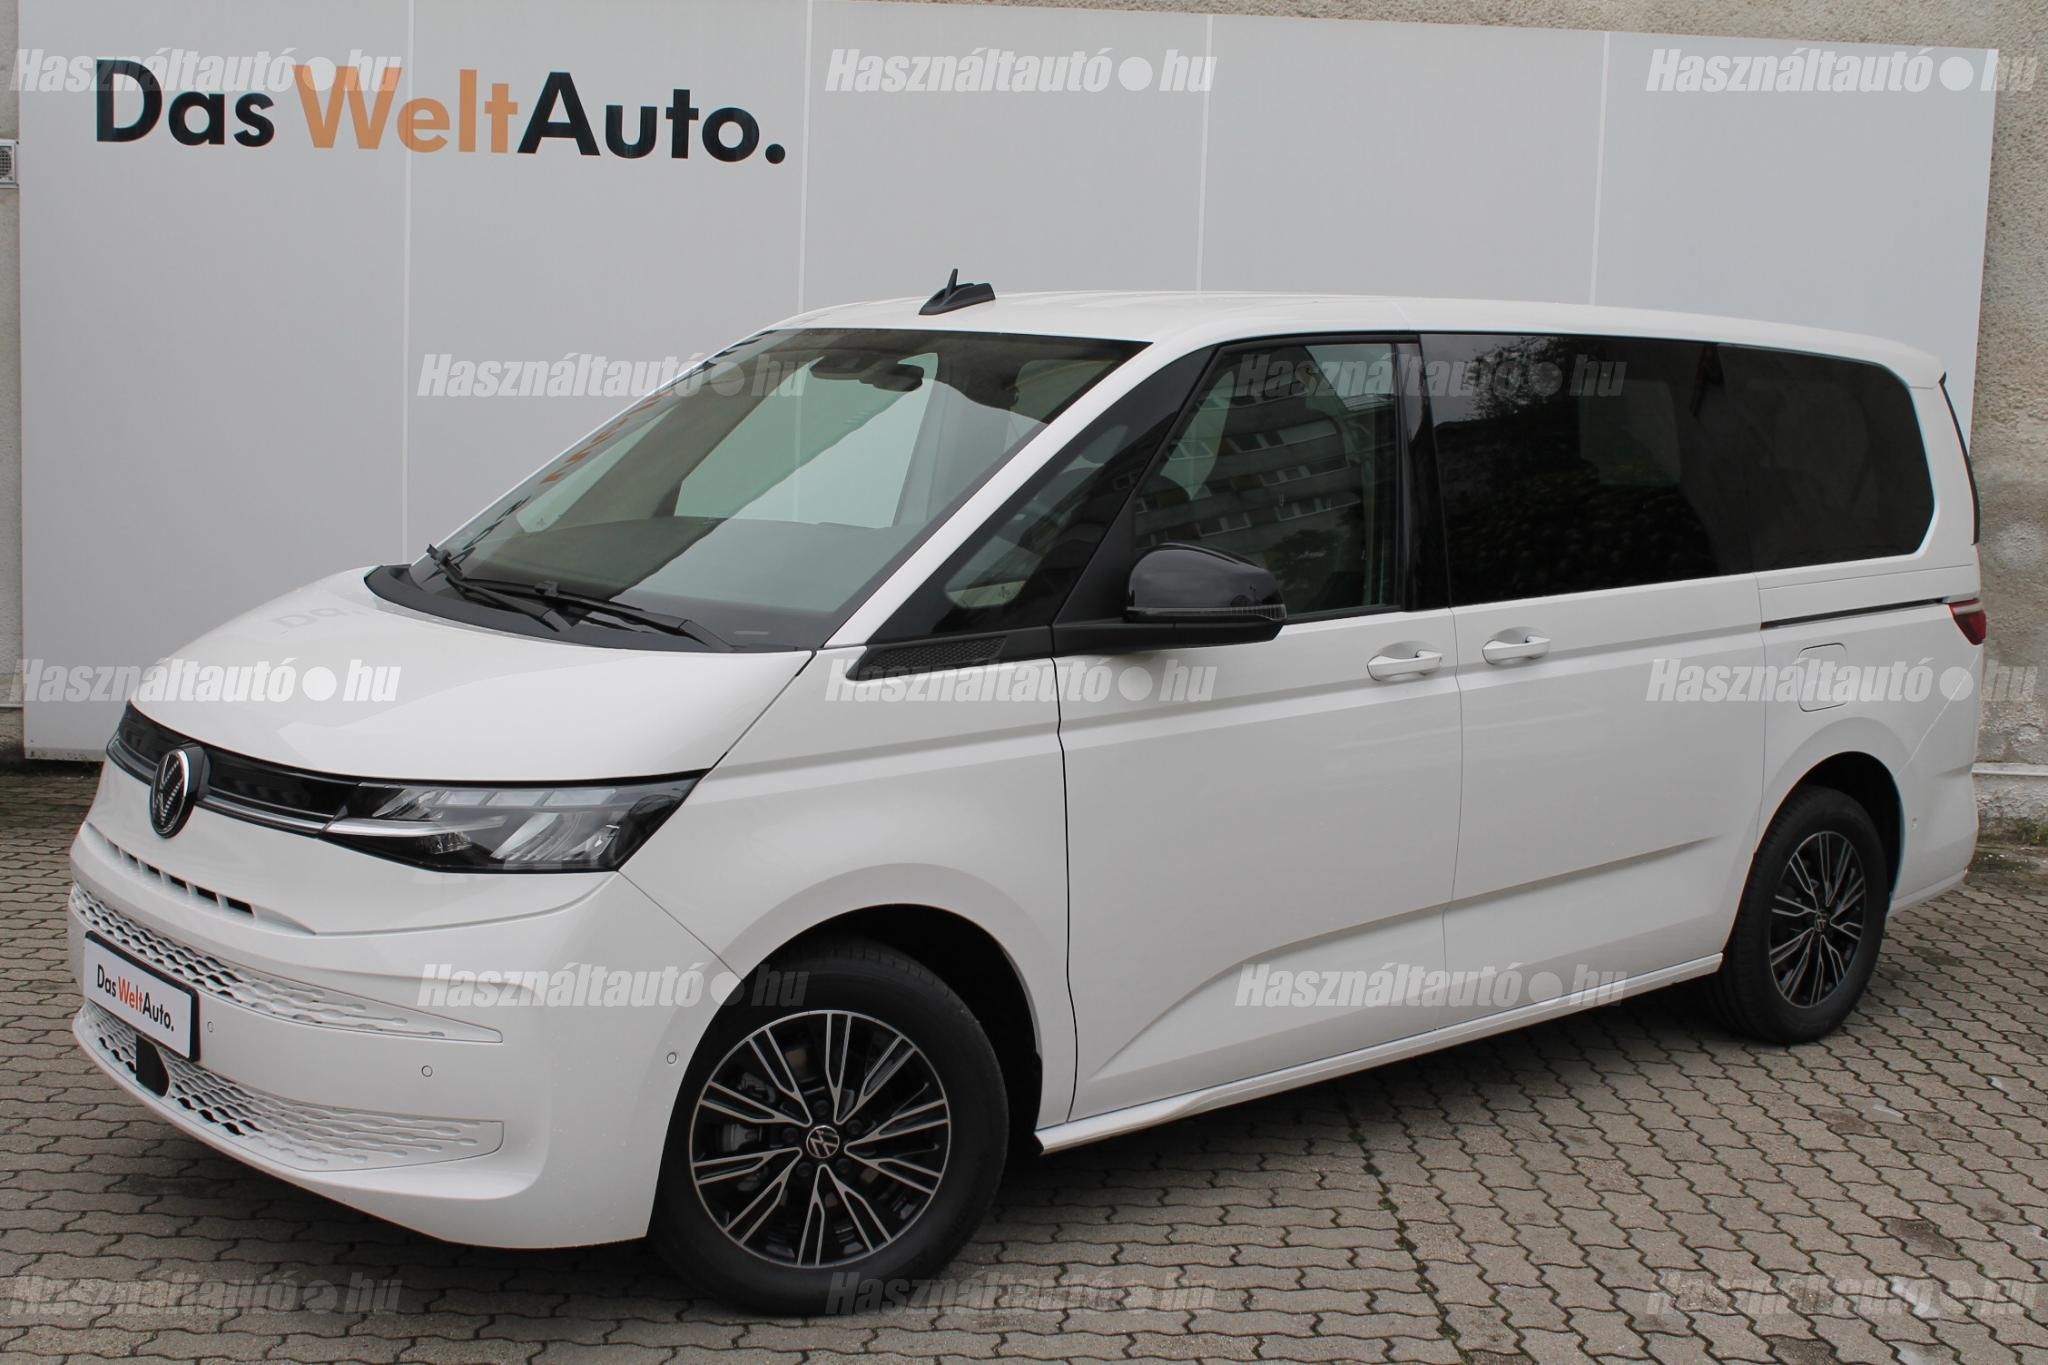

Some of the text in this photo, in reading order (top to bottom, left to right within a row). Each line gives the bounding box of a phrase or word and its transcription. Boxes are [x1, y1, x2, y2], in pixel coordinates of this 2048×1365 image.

[96, 58, 786, 165] Das WeltAuto.
[97, 963, 175, 1032] Das WeltAuto.
